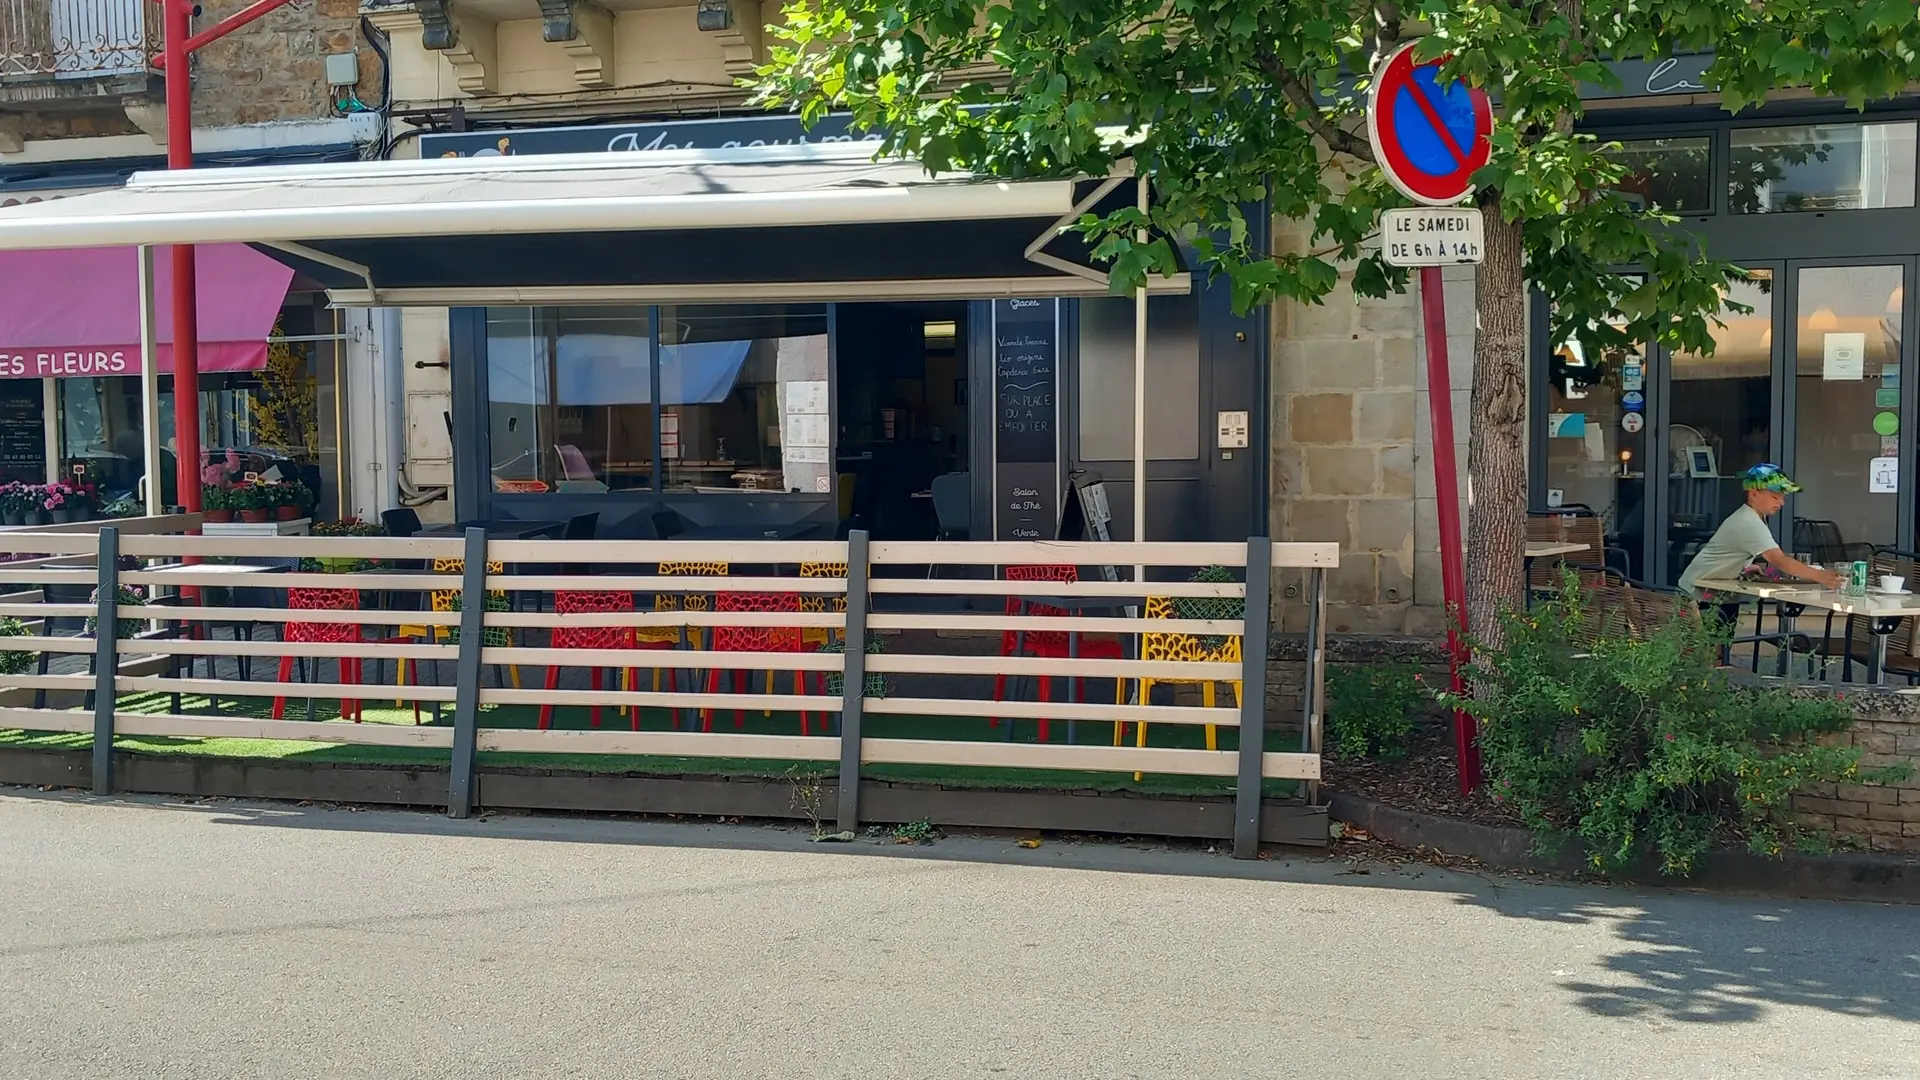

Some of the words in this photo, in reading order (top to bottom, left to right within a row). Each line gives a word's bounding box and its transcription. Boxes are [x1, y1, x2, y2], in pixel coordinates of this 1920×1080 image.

[1396, 218, 1411, 232] LE
[1418, 217, 1470, 232] SAMEDI
[1391, 243, 1409, 257] DE
[1438, 240, 1447, 256] À
[36, 351, 126, 375] FLEURS
[1023, 394, 1052, 407] PLACE
[1005, 408, 1019, 419] OU
[999, 421, 1049, 433] EMPOTER
[1012, 487, 1039, 497] Salon
[1010, 502, 1022, 510] de
[1023, 501, 1041, 510] Thé
[1012, 528, 1040, 538] Vente
